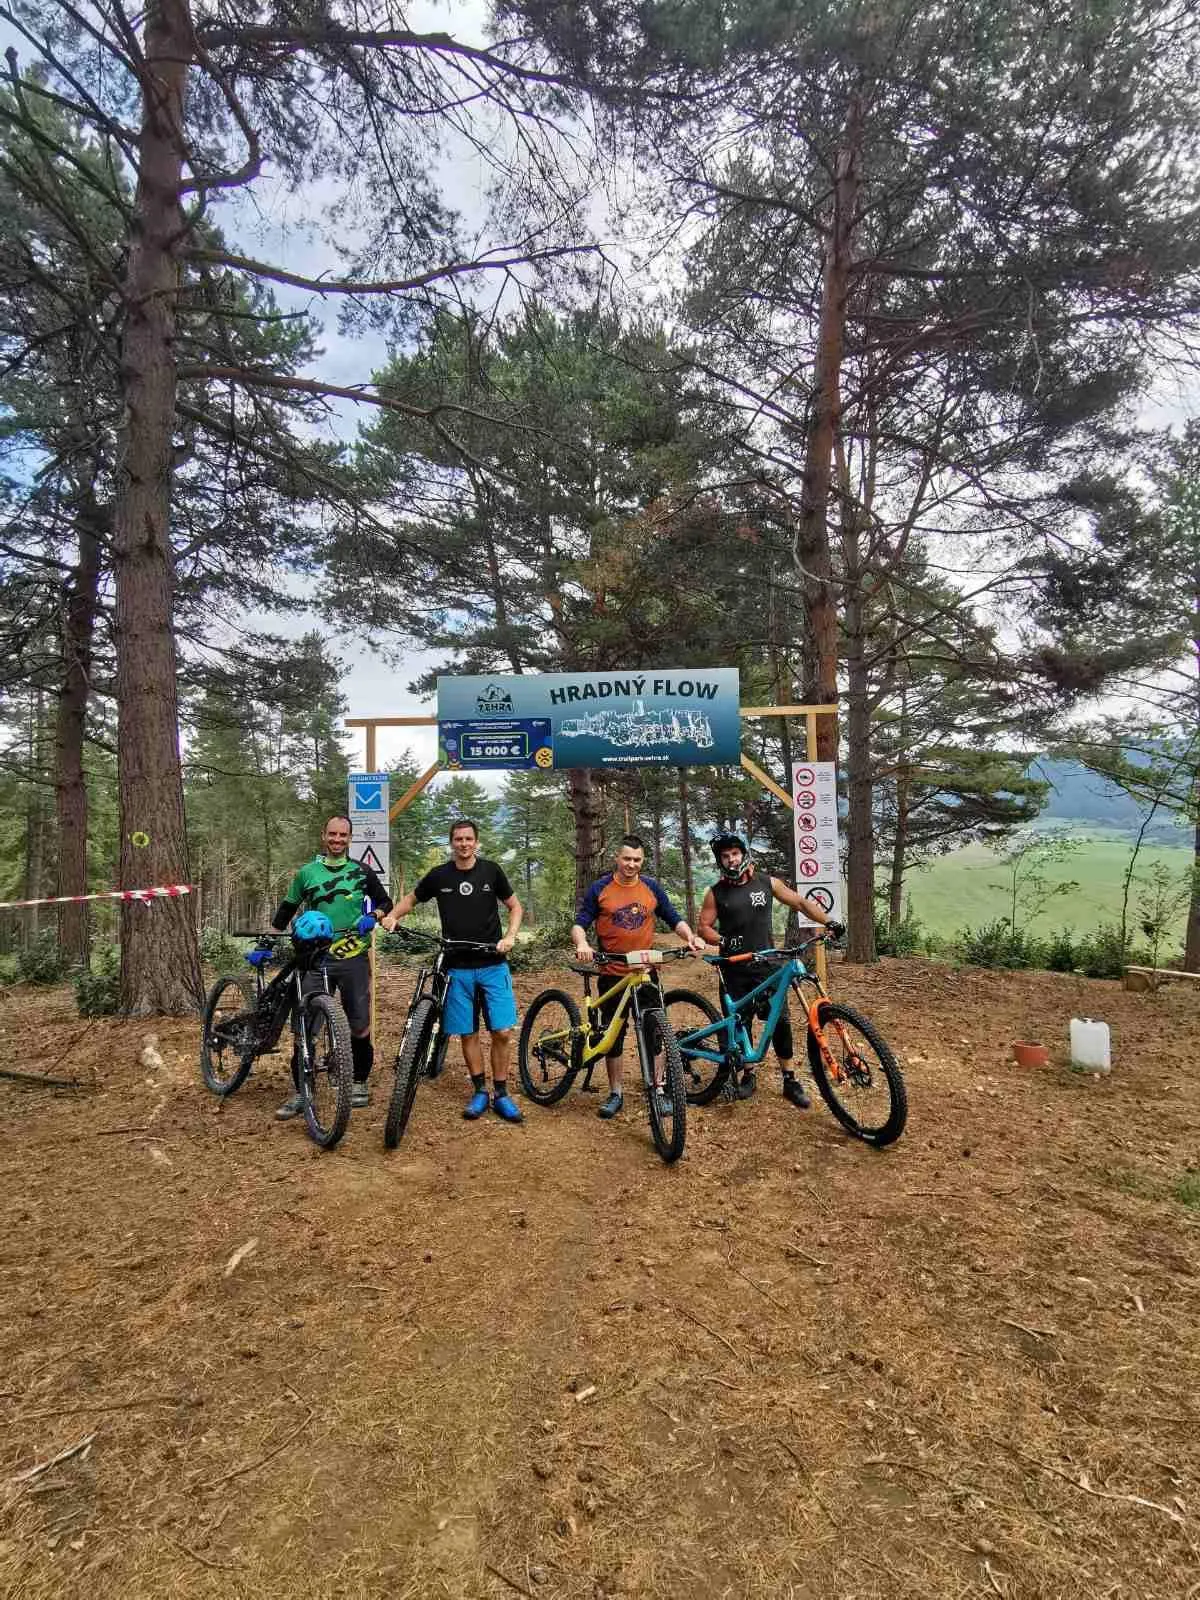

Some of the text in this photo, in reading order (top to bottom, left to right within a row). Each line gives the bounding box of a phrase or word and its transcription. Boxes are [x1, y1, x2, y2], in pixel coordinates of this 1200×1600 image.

[550, 674, 719, 705] HRADNÝ FLOW
[470, 745, 521, 756] 15 000 €
